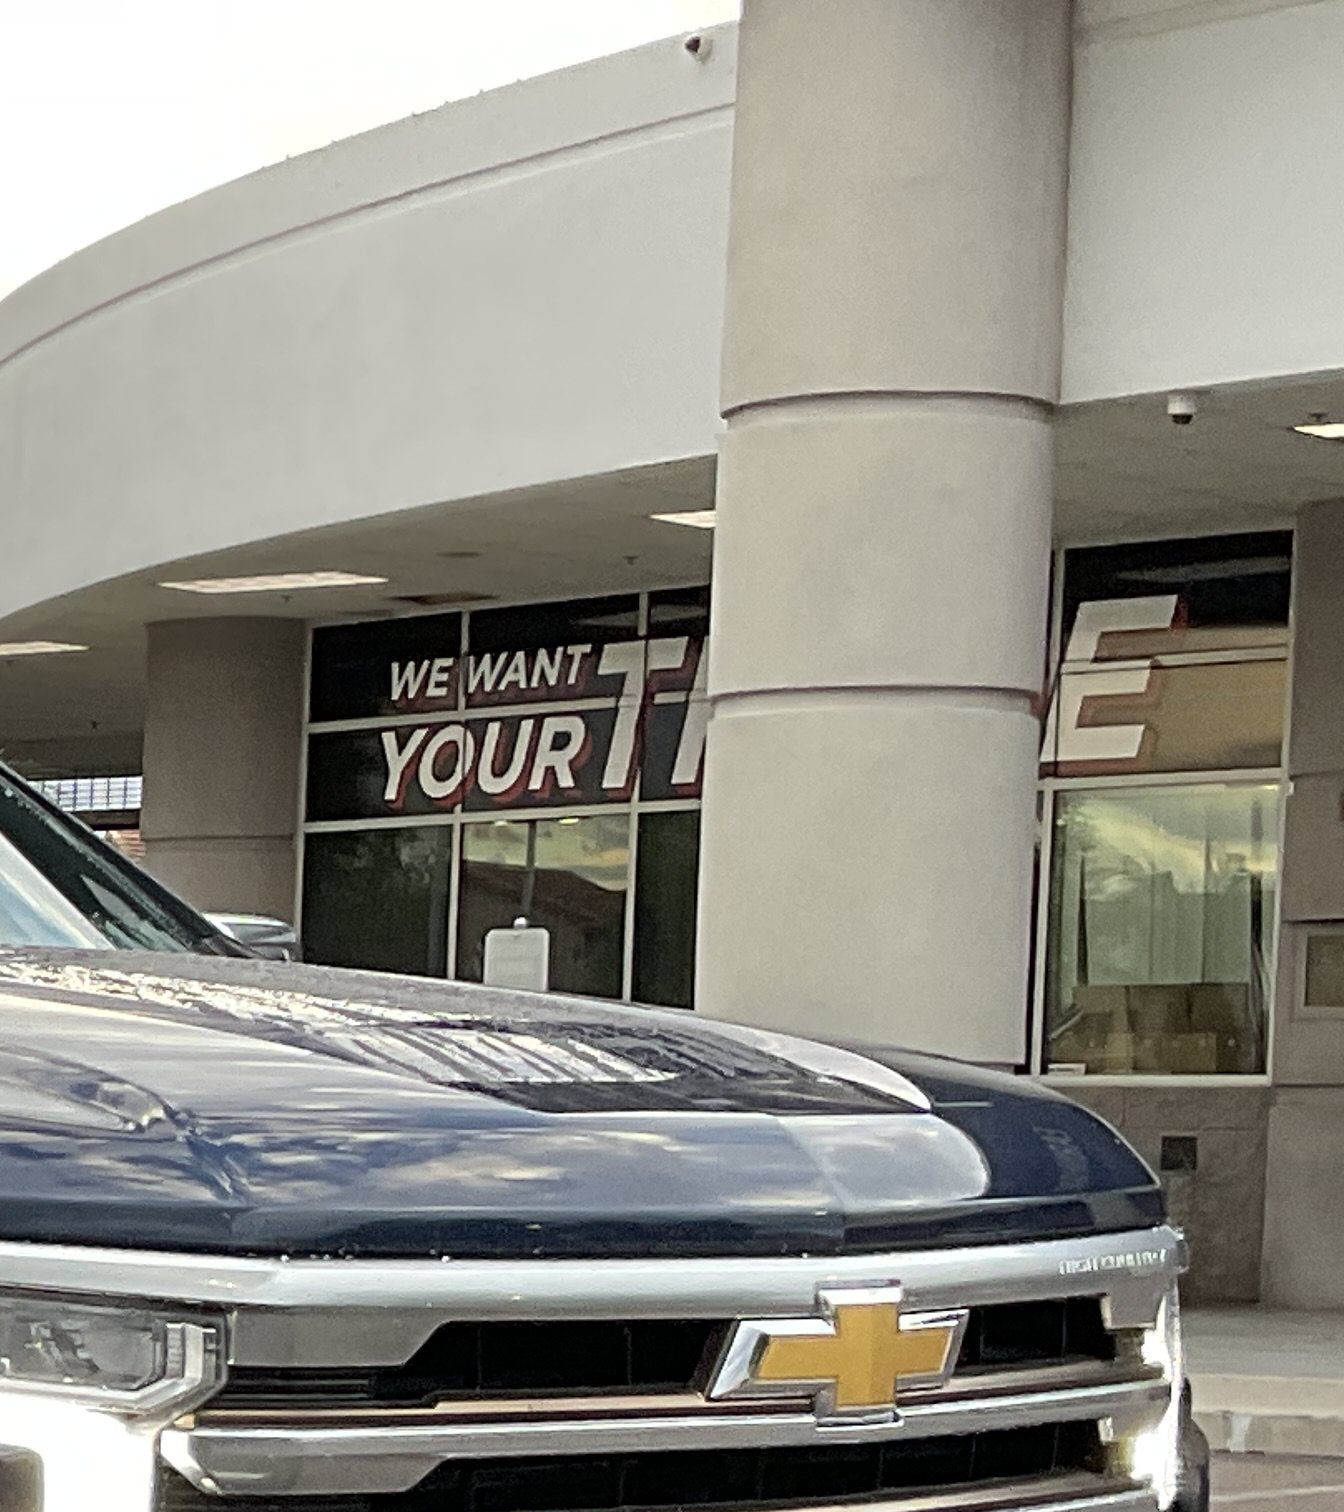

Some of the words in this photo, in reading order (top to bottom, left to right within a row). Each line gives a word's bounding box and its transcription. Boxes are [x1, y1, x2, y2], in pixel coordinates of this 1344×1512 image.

[390, 657, 454, 701] WE
[466, 643, 592, 694] WANT
[380, 715, 587, 801] YOUR
